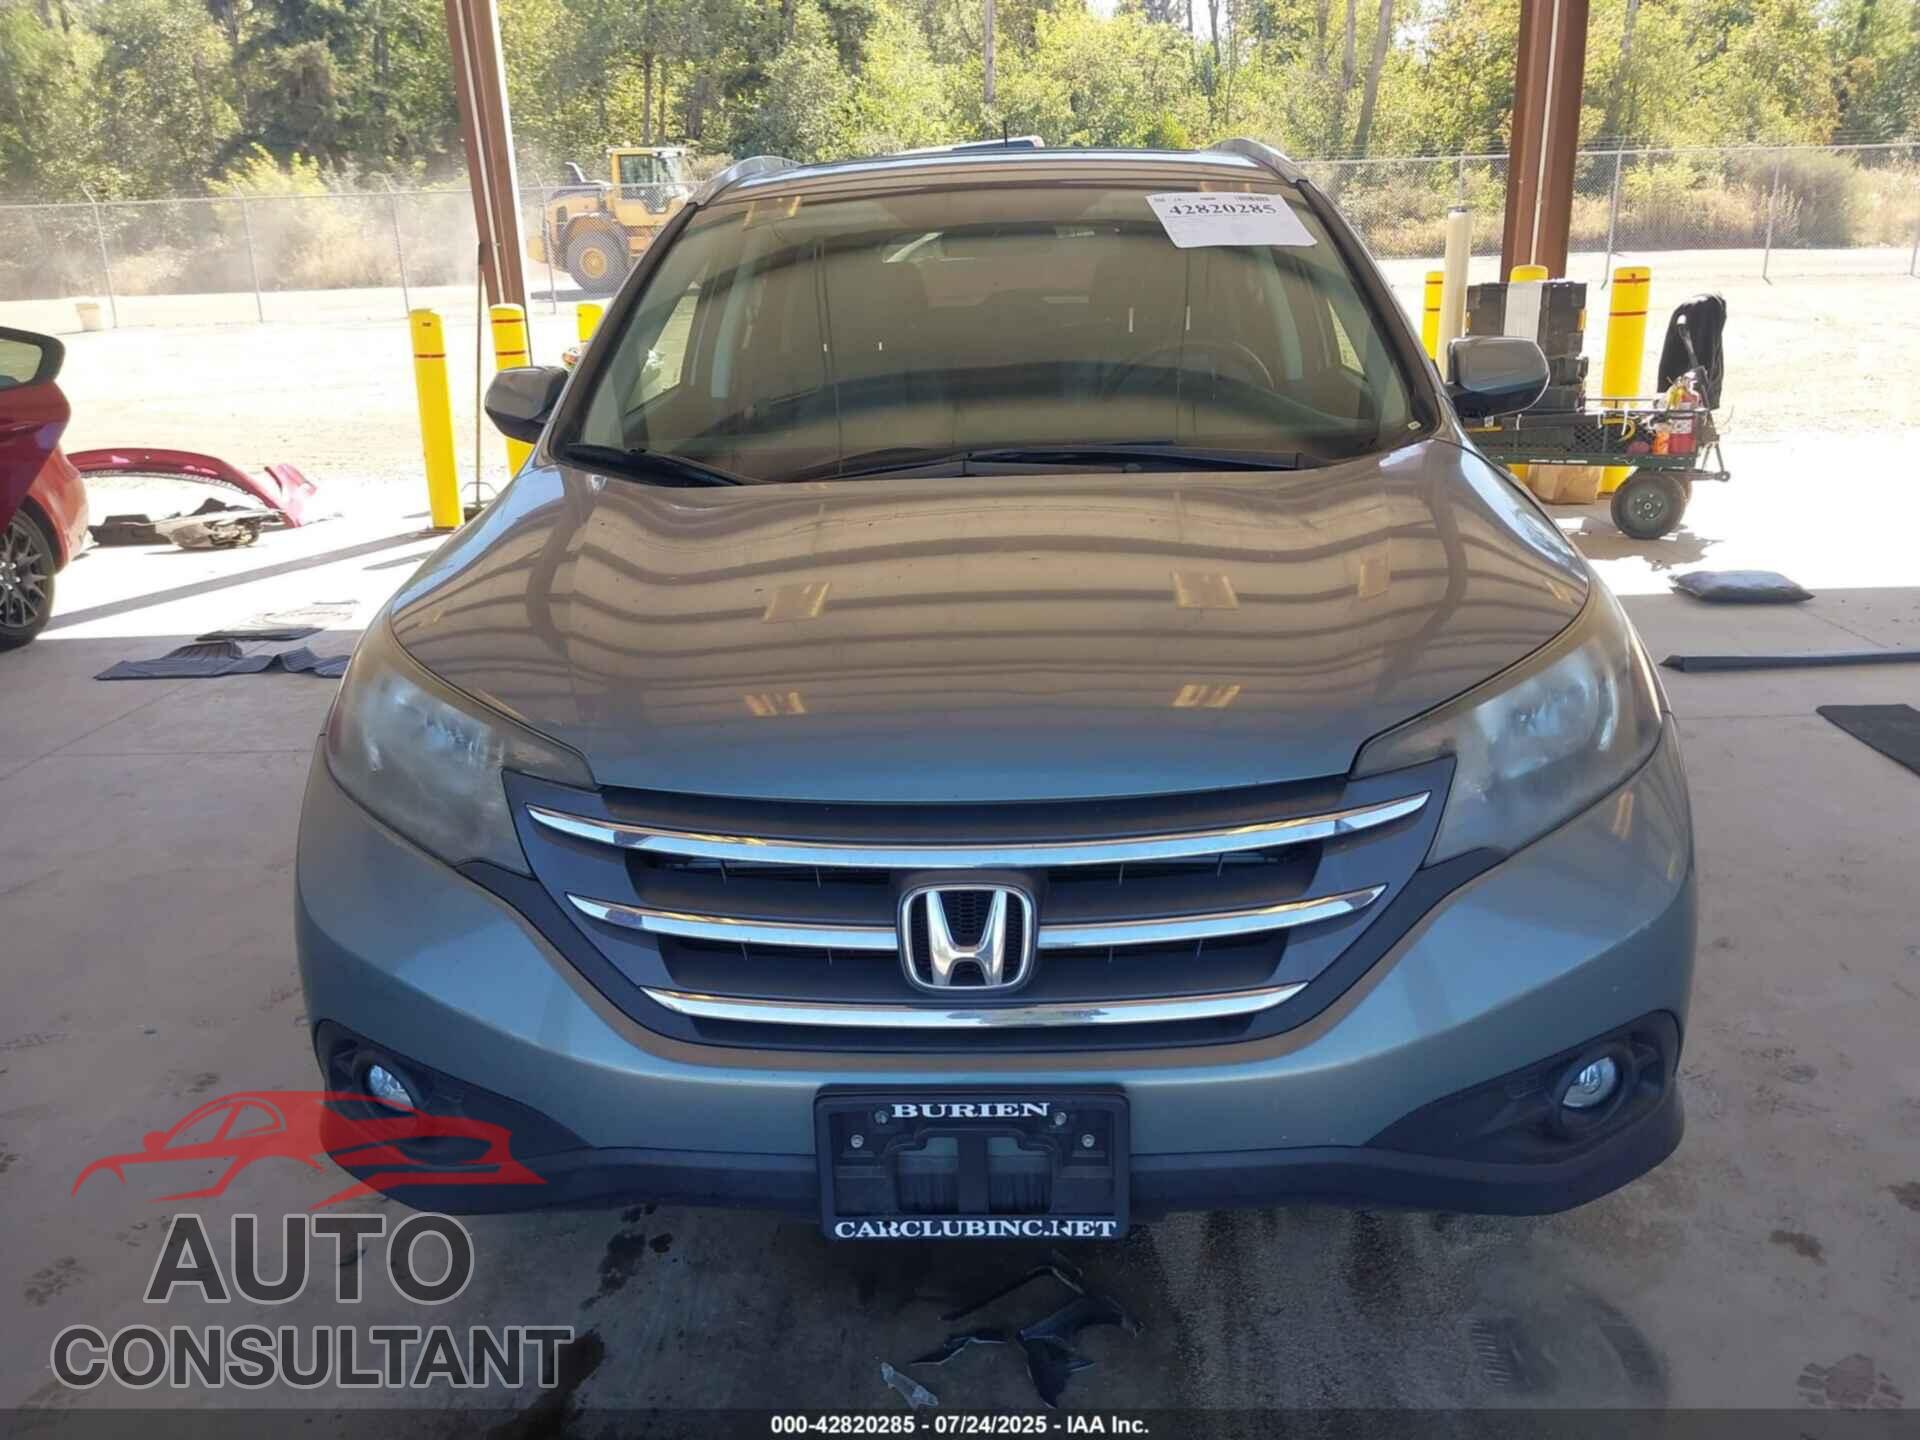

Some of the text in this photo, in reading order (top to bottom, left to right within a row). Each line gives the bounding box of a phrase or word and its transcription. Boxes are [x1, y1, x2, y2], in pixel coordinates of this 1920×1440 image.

[1169, 204, 1277, 216] 42820285
[892, 1103, 1050, 1118] BURIEN
[835, 1221, 1117, 1238] CARCLUBINC.NET
